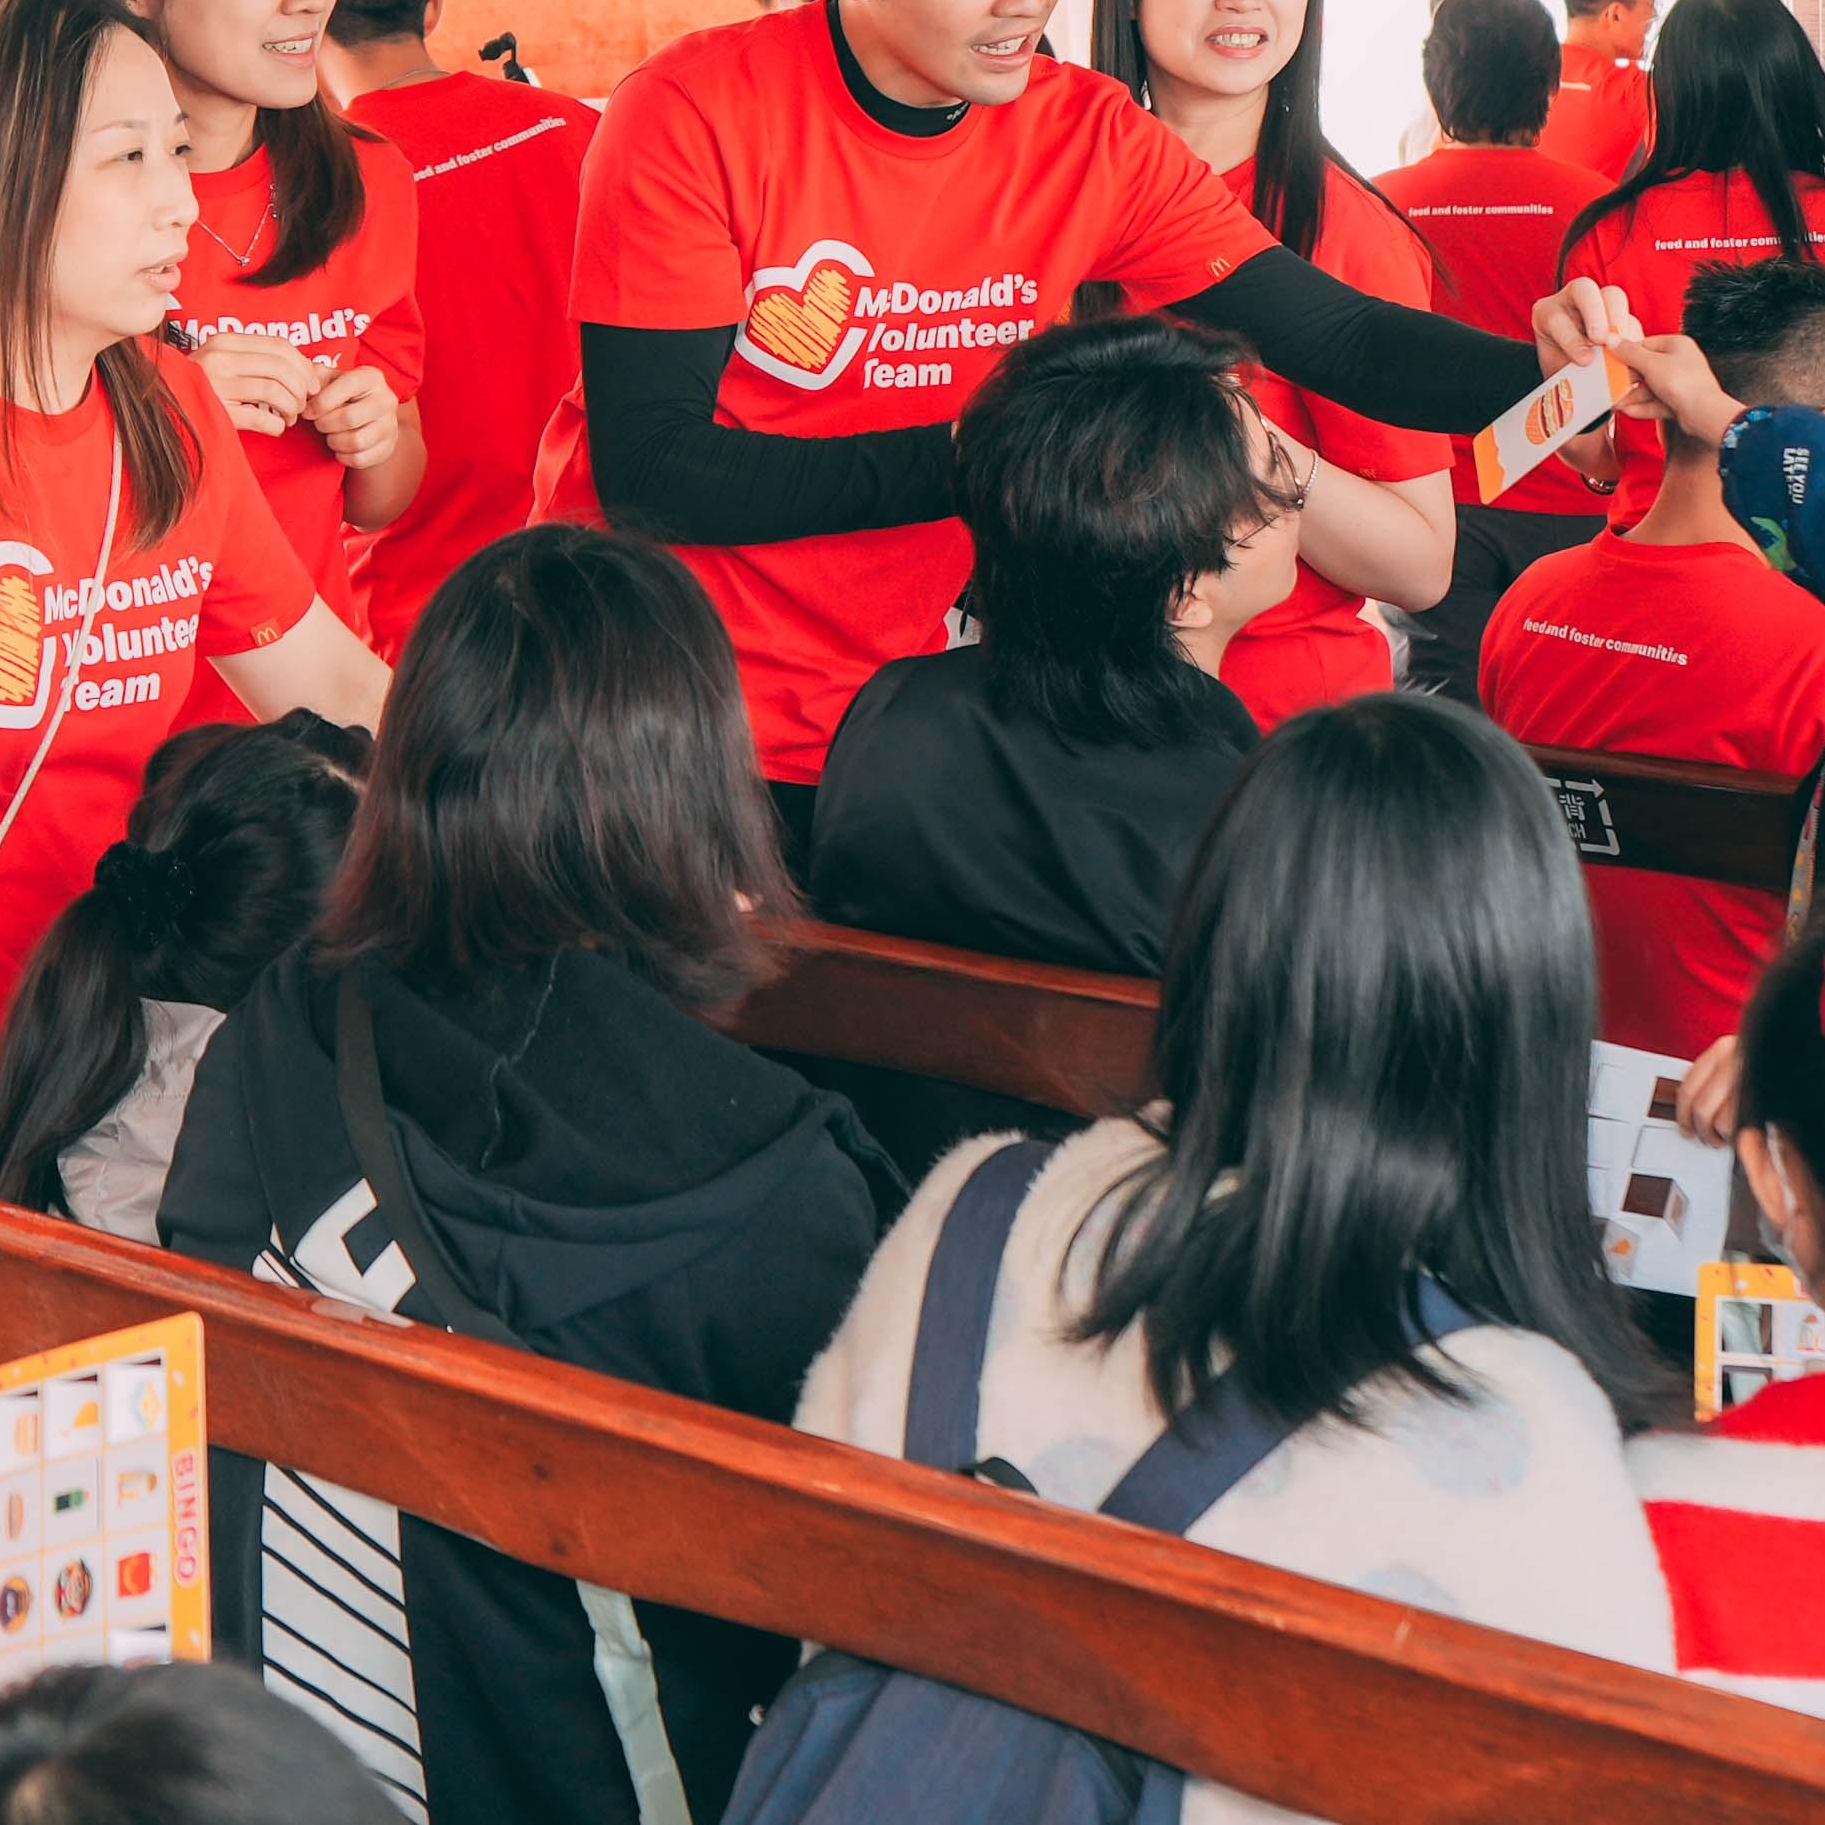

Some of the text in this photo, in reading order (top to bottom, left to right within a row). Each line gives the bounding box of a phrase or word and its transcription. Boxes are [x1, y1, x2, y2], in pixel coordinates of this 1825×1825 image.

[435, 157, 455, 177] and
[456, 142, 493, 168] foster
[493, 116, 567, 155] communities
[1432, 205, 1452, 216] and
[1485, 204, 1554, 216] communities
[1684, 237, 1707, 250] and
[1709, 236, 1748, 249] foster
[1569, 628, 1605, 651] foster
[1605, 637, 1689, 668] communities
[173, 1453, 198, 1581] BINGO
